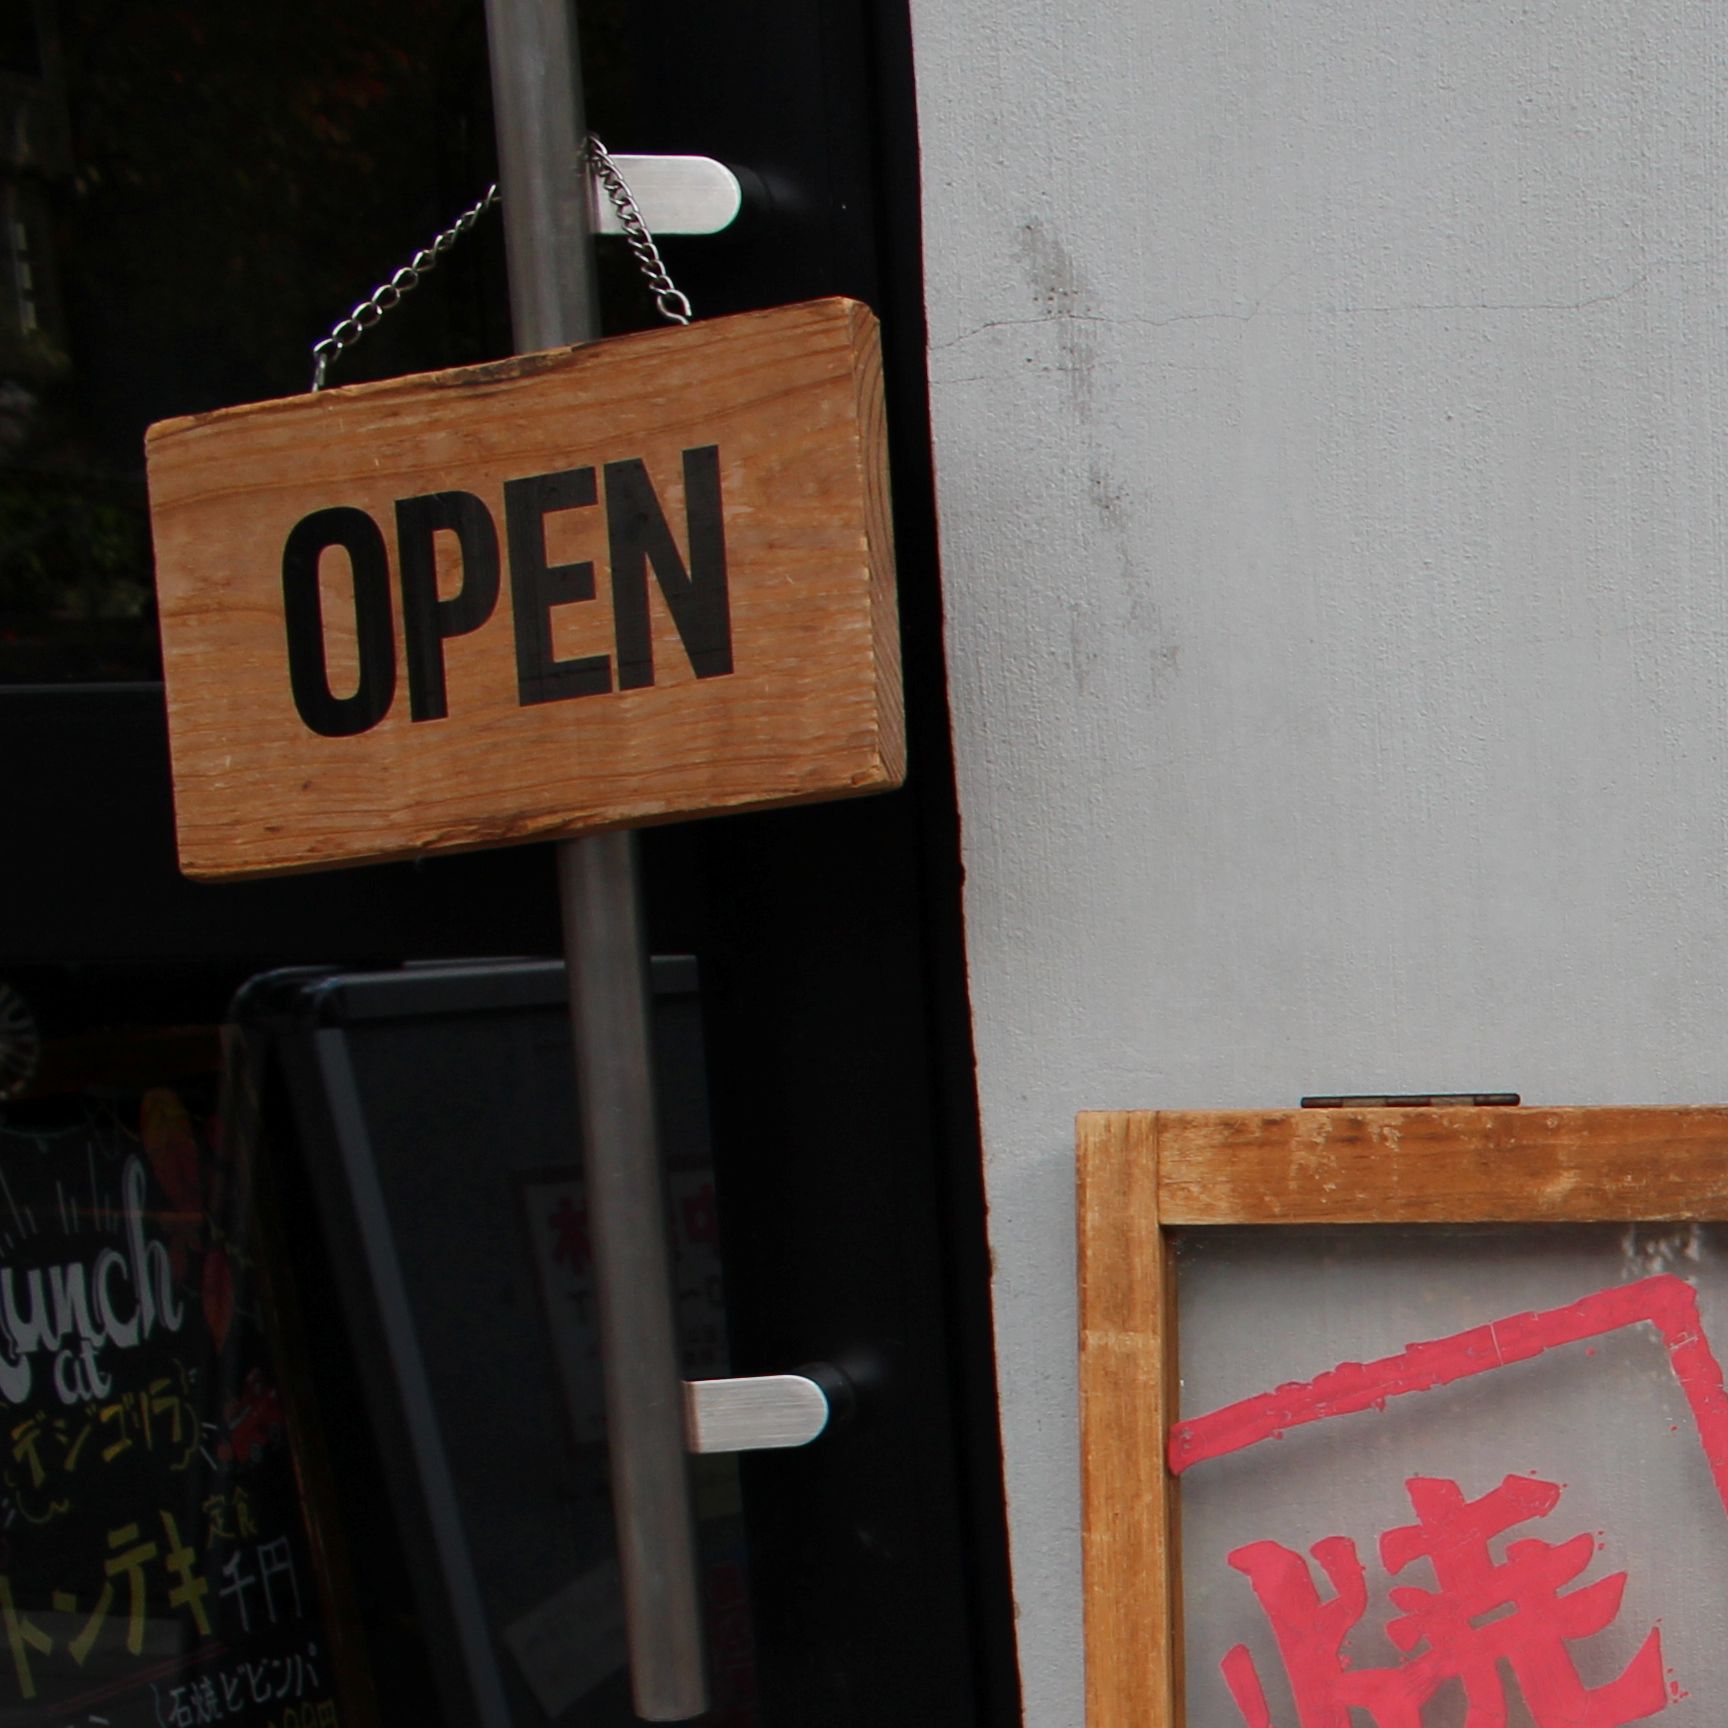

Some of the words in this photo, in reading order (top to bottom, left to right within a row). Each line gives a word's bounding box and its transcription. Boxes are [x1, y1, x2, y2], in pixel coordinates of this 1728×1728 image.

[281, 444, 735, 738] OPEN
[9, 1376, 184, 1489] デジゴリラ
[53, 1336, 113, 1406] at
[0, 1507, 213, 1700] トンテキ
[218, 1535, 304, 1634] 千円
